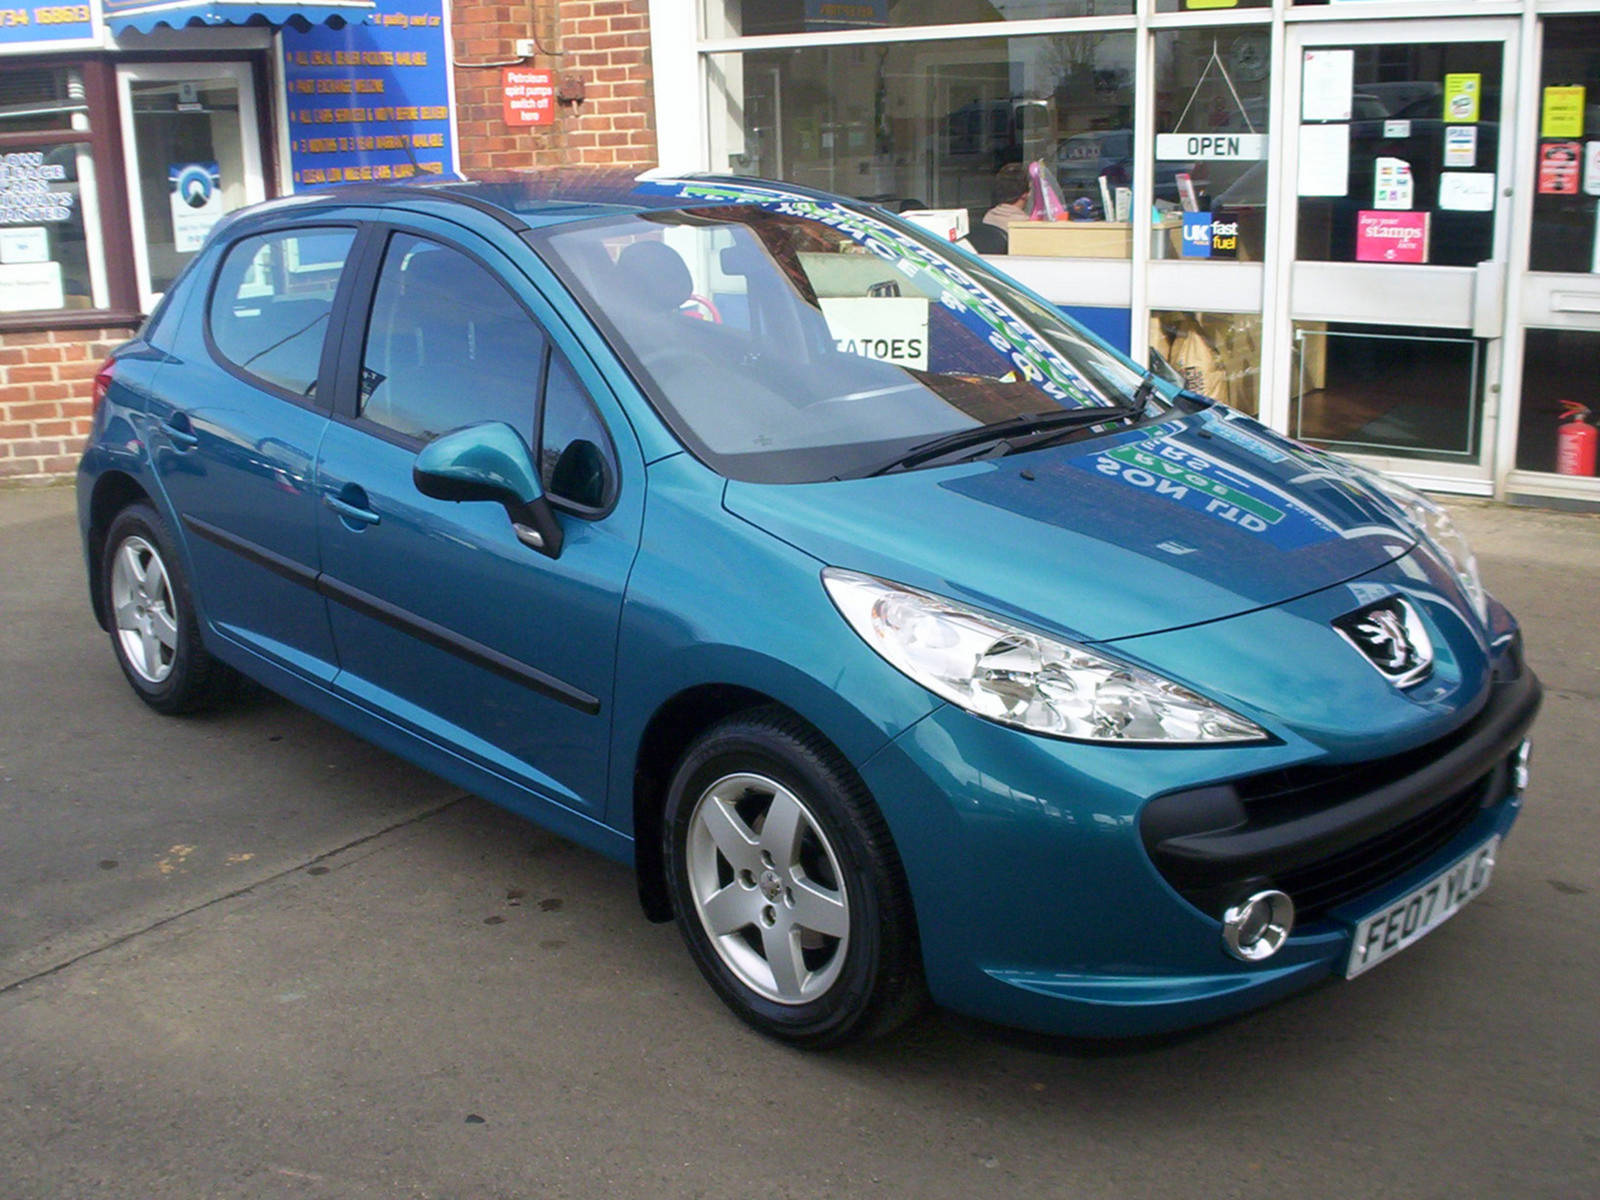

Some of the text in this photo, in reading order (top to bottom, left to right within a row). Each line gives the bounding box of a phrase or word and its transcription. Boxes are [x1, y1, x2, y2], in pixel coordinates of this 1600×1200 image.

[1187, 136, 1240, 156] OPEN
[1183, 224, 1210, 241] UK
[1210, 221, 1238, 235] fast
[1365, 226, 1422, 242] stamps
[1212, 235, 1237, 249] fuel
[1362, 883, 1442, 964] FE07
